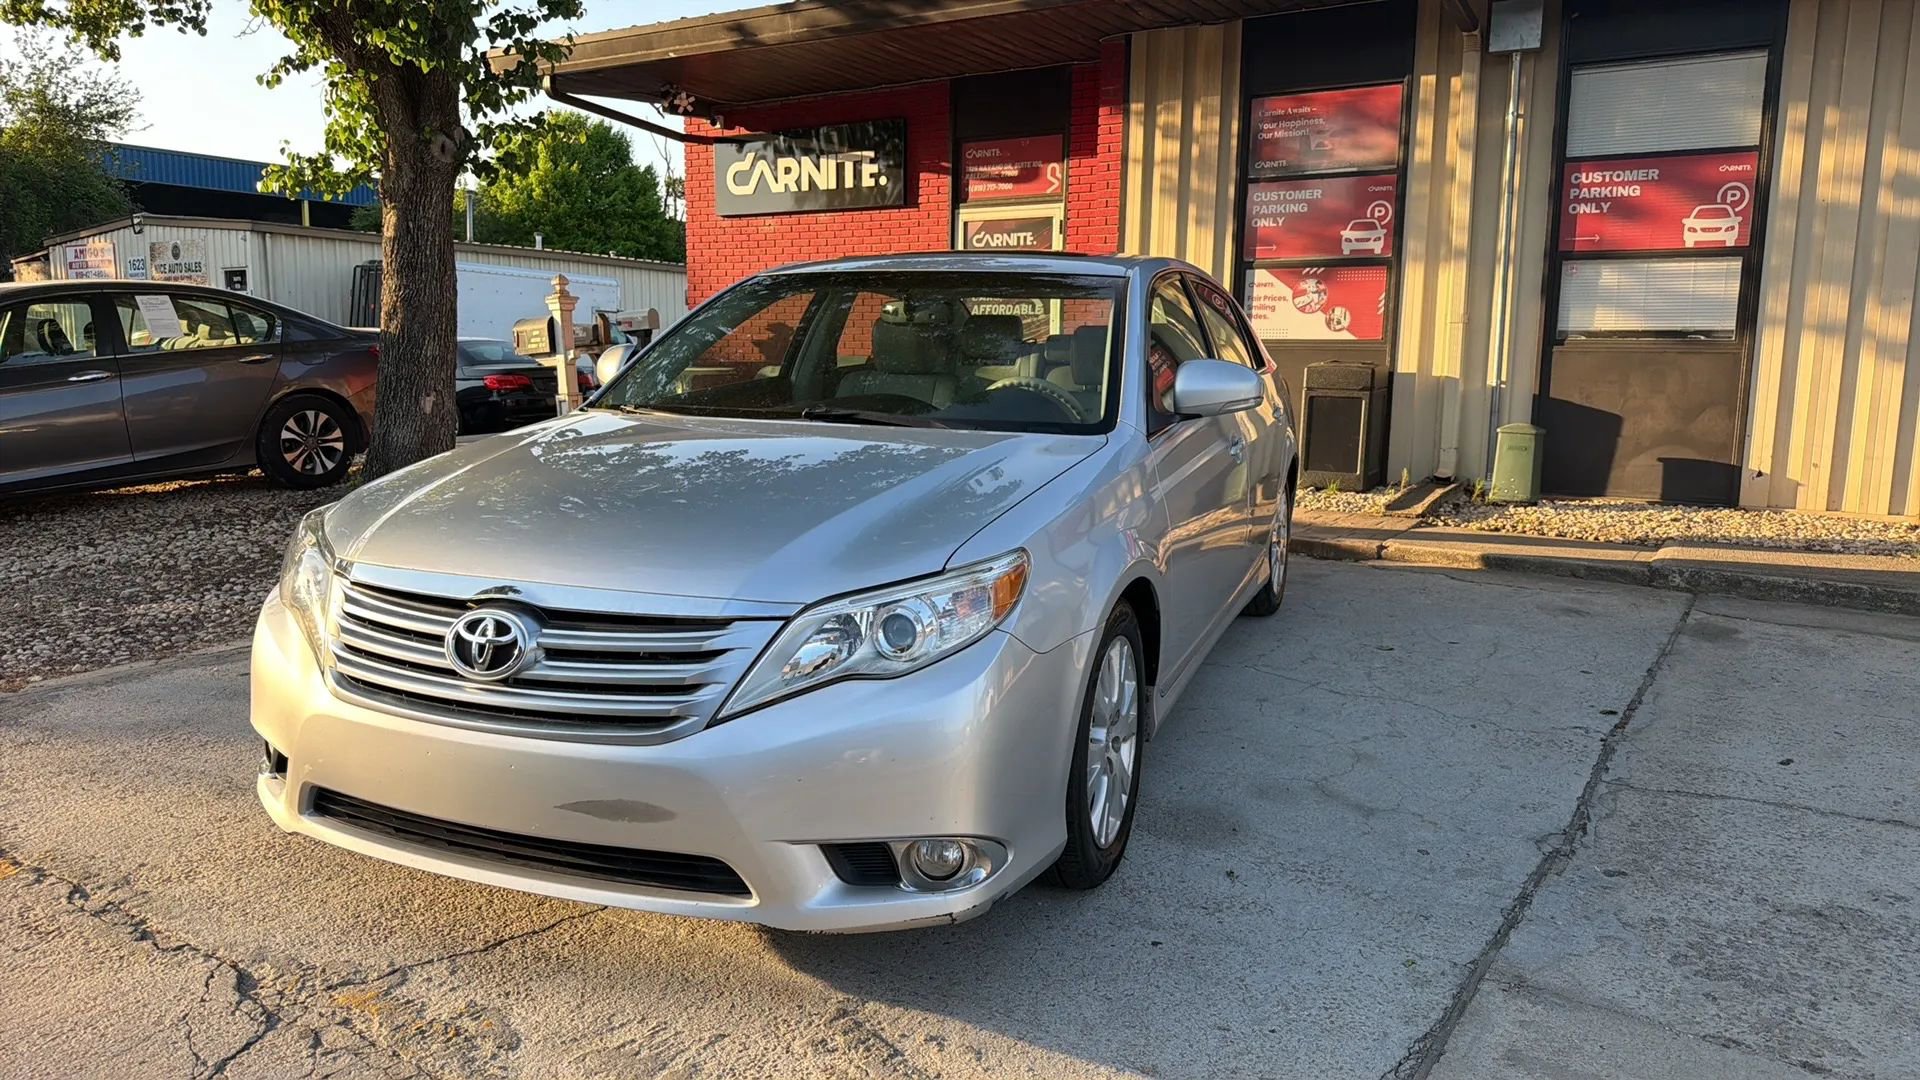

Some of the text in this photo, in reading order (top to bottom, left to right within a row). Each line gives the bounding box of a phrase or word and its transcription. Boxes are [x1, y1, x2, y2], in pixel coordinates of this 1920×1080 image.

[1286, 106, 1311, 115] Awaits
[1258, 118, 1326, 130] Your Happiness,
[1258, 128, 1310, 140] Our Mission!
[1571, 169, 1660, 184] CUSTOMER
[1253, 189, 1322, 202] CUSTOMER
[1569, 186, 1641, 200] PARKING
[1252, 203, 1308, 215] PARKING
[1568, 202, 1612, 215] ONLY
[1252, 217, 1285, 228] ONLY
[128, 259, 145, 271] 1623
[168, 262, 183, 273] AUTO
[184, 261, 202, 273] SALES
[971, 303, 1044, 316] AFFORDABLE
